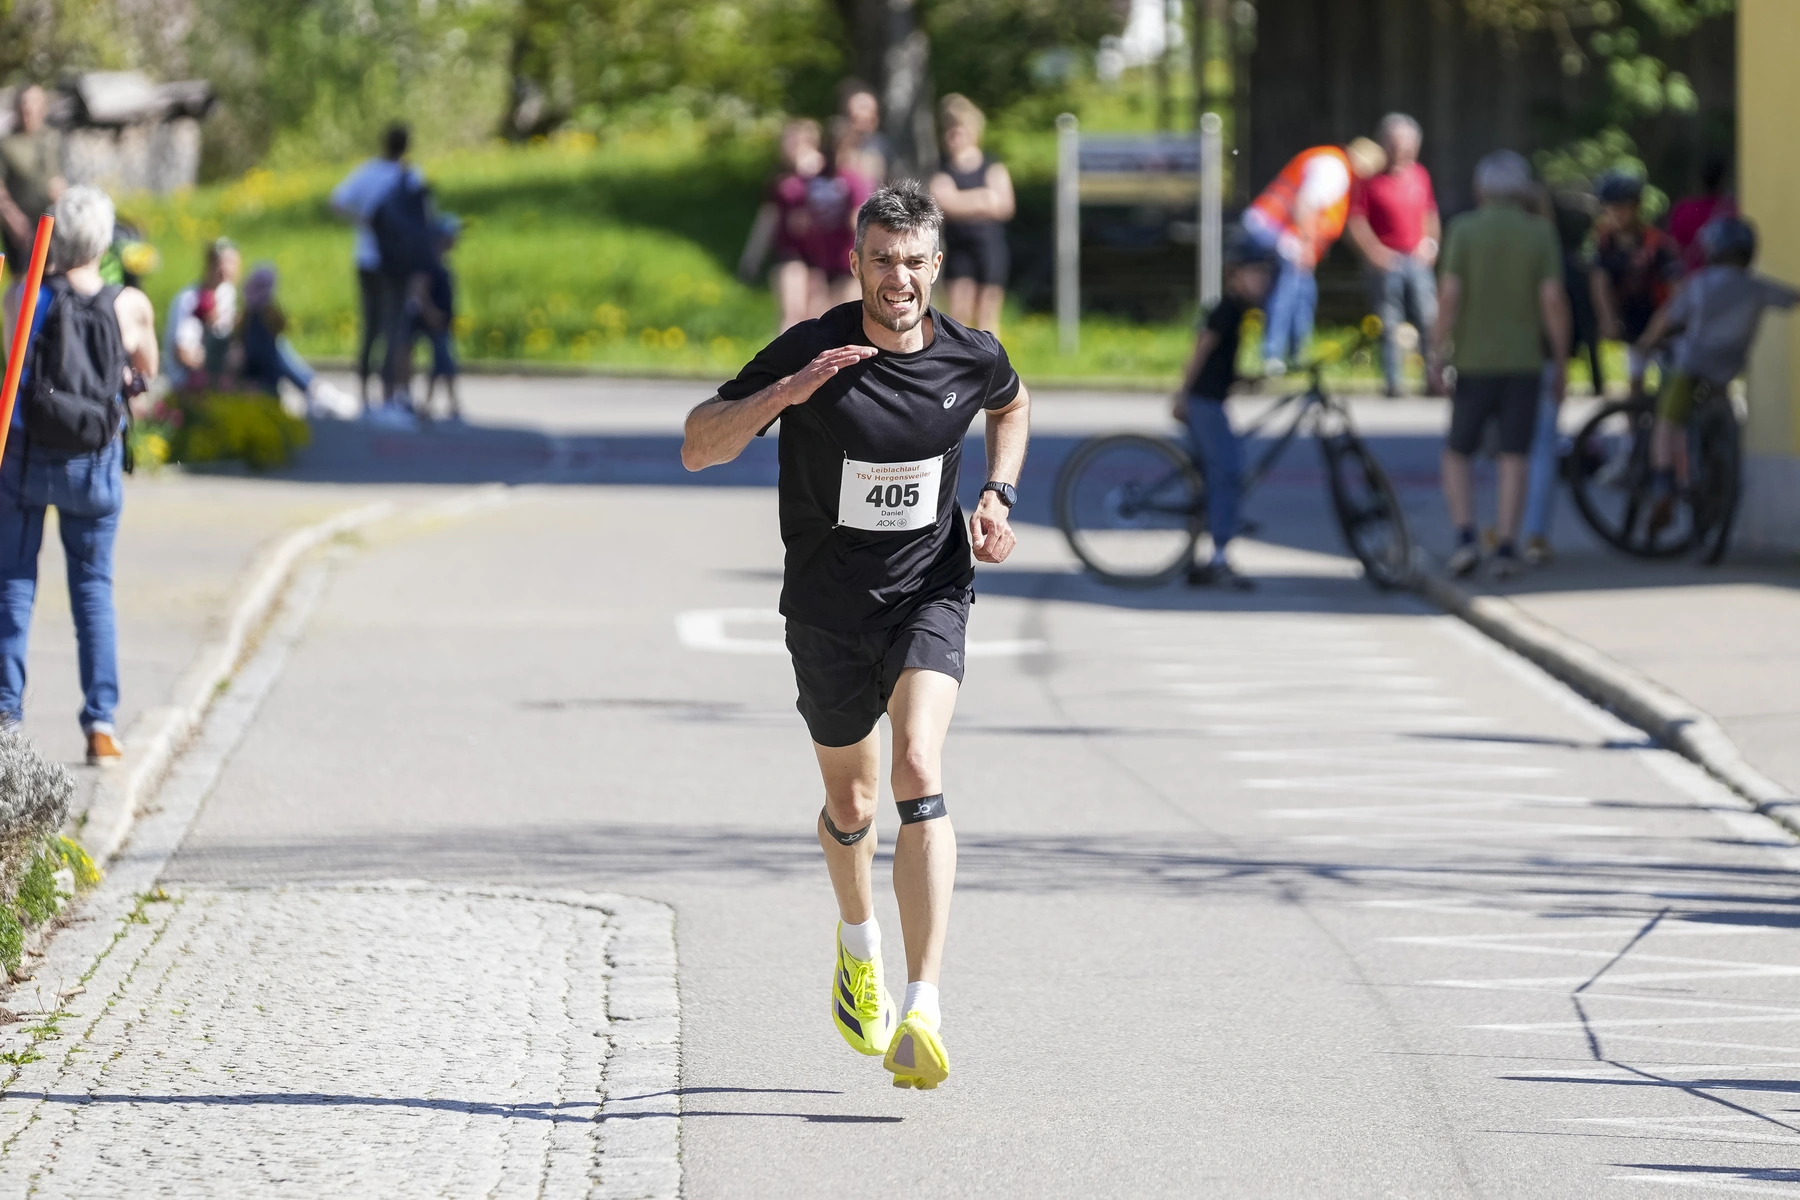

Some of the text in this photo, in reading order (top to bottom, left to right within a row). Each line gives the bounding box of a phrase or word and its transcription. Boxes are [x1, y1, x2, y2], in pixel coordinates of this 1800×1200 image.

[871, 465, 921, 474] Leiblachlauf
[856, 471, 931, 482] TSV Hergensweiler
[865, 483, 920, 508] 405
[875, 519, 897, 527] AOK
